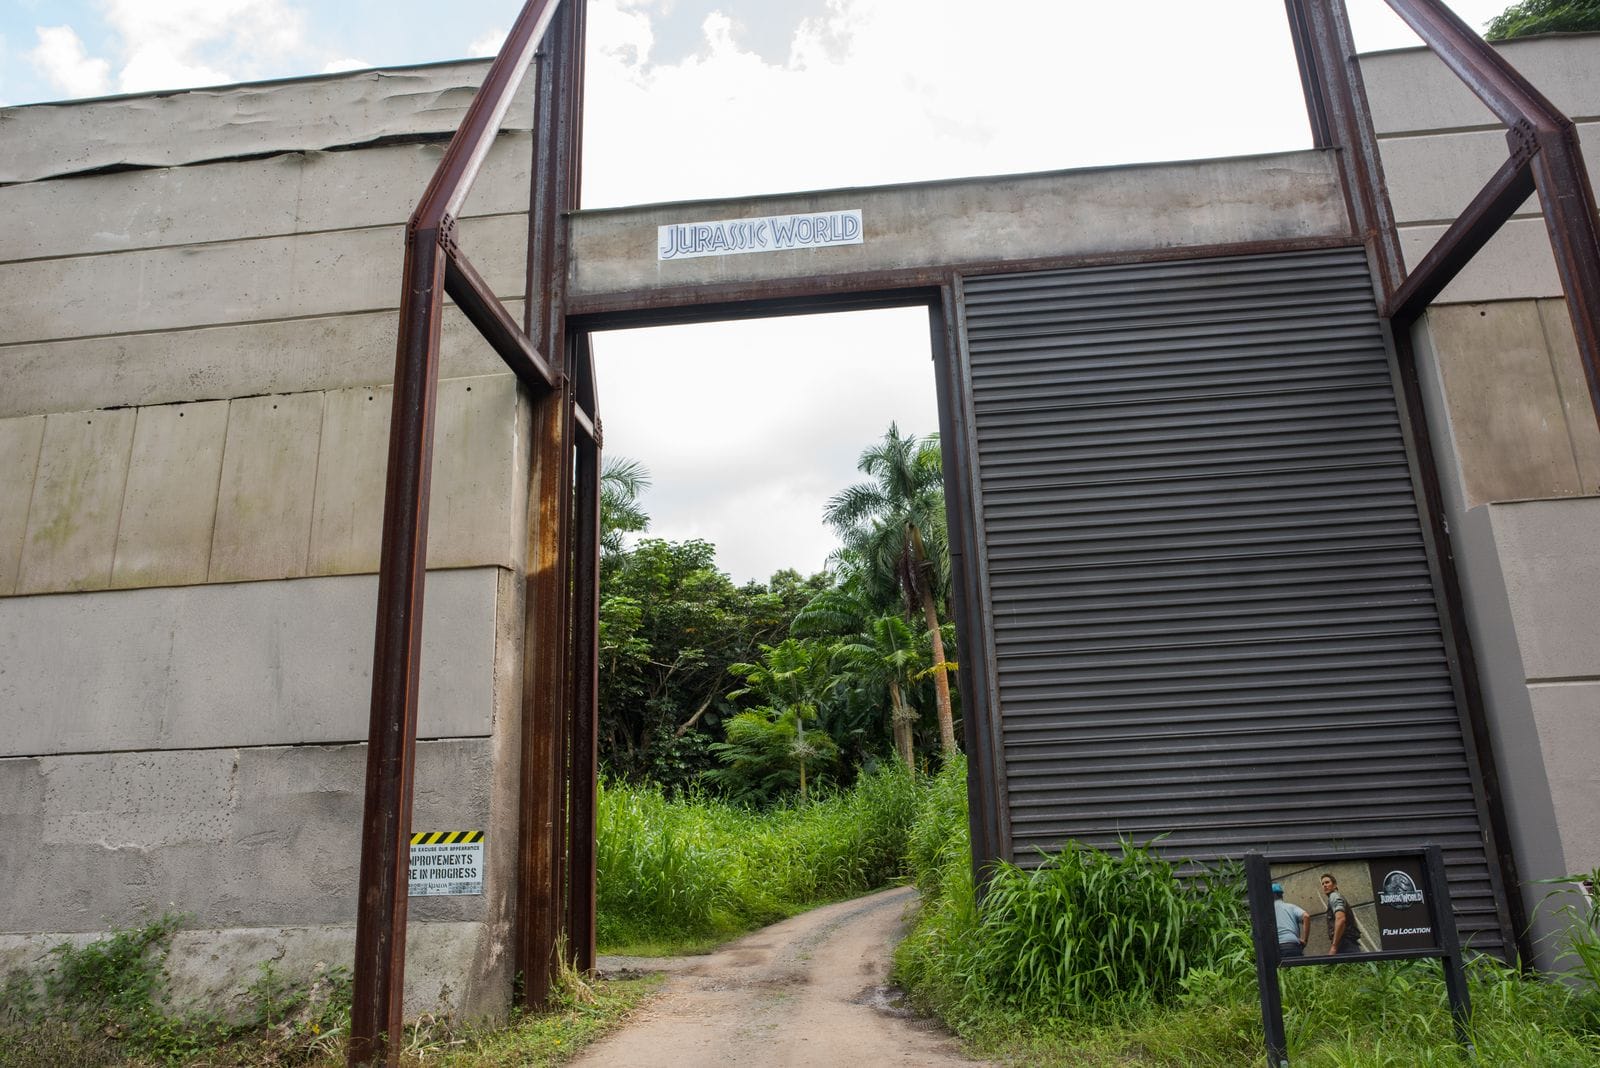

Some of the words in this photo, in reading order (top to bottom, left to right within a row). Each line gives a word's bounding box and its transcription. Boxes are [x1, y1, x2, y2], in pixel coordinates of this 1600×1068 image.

[661, 220, 770, 258] JURASSIC
[769, 214, 861, 248] WORLD
[409, 854, 473, 866] MPROVEMENTS
[408, 869, 418, 880] RE
[420, 868, 428, 879] IN
[430, 867, 477, 879] PROGRESS
[1401, 893, 1422, 903] WORLD
[1382, 928, 1398, 936] FILM
[1398, 927, 1431, 935] LOCATION
